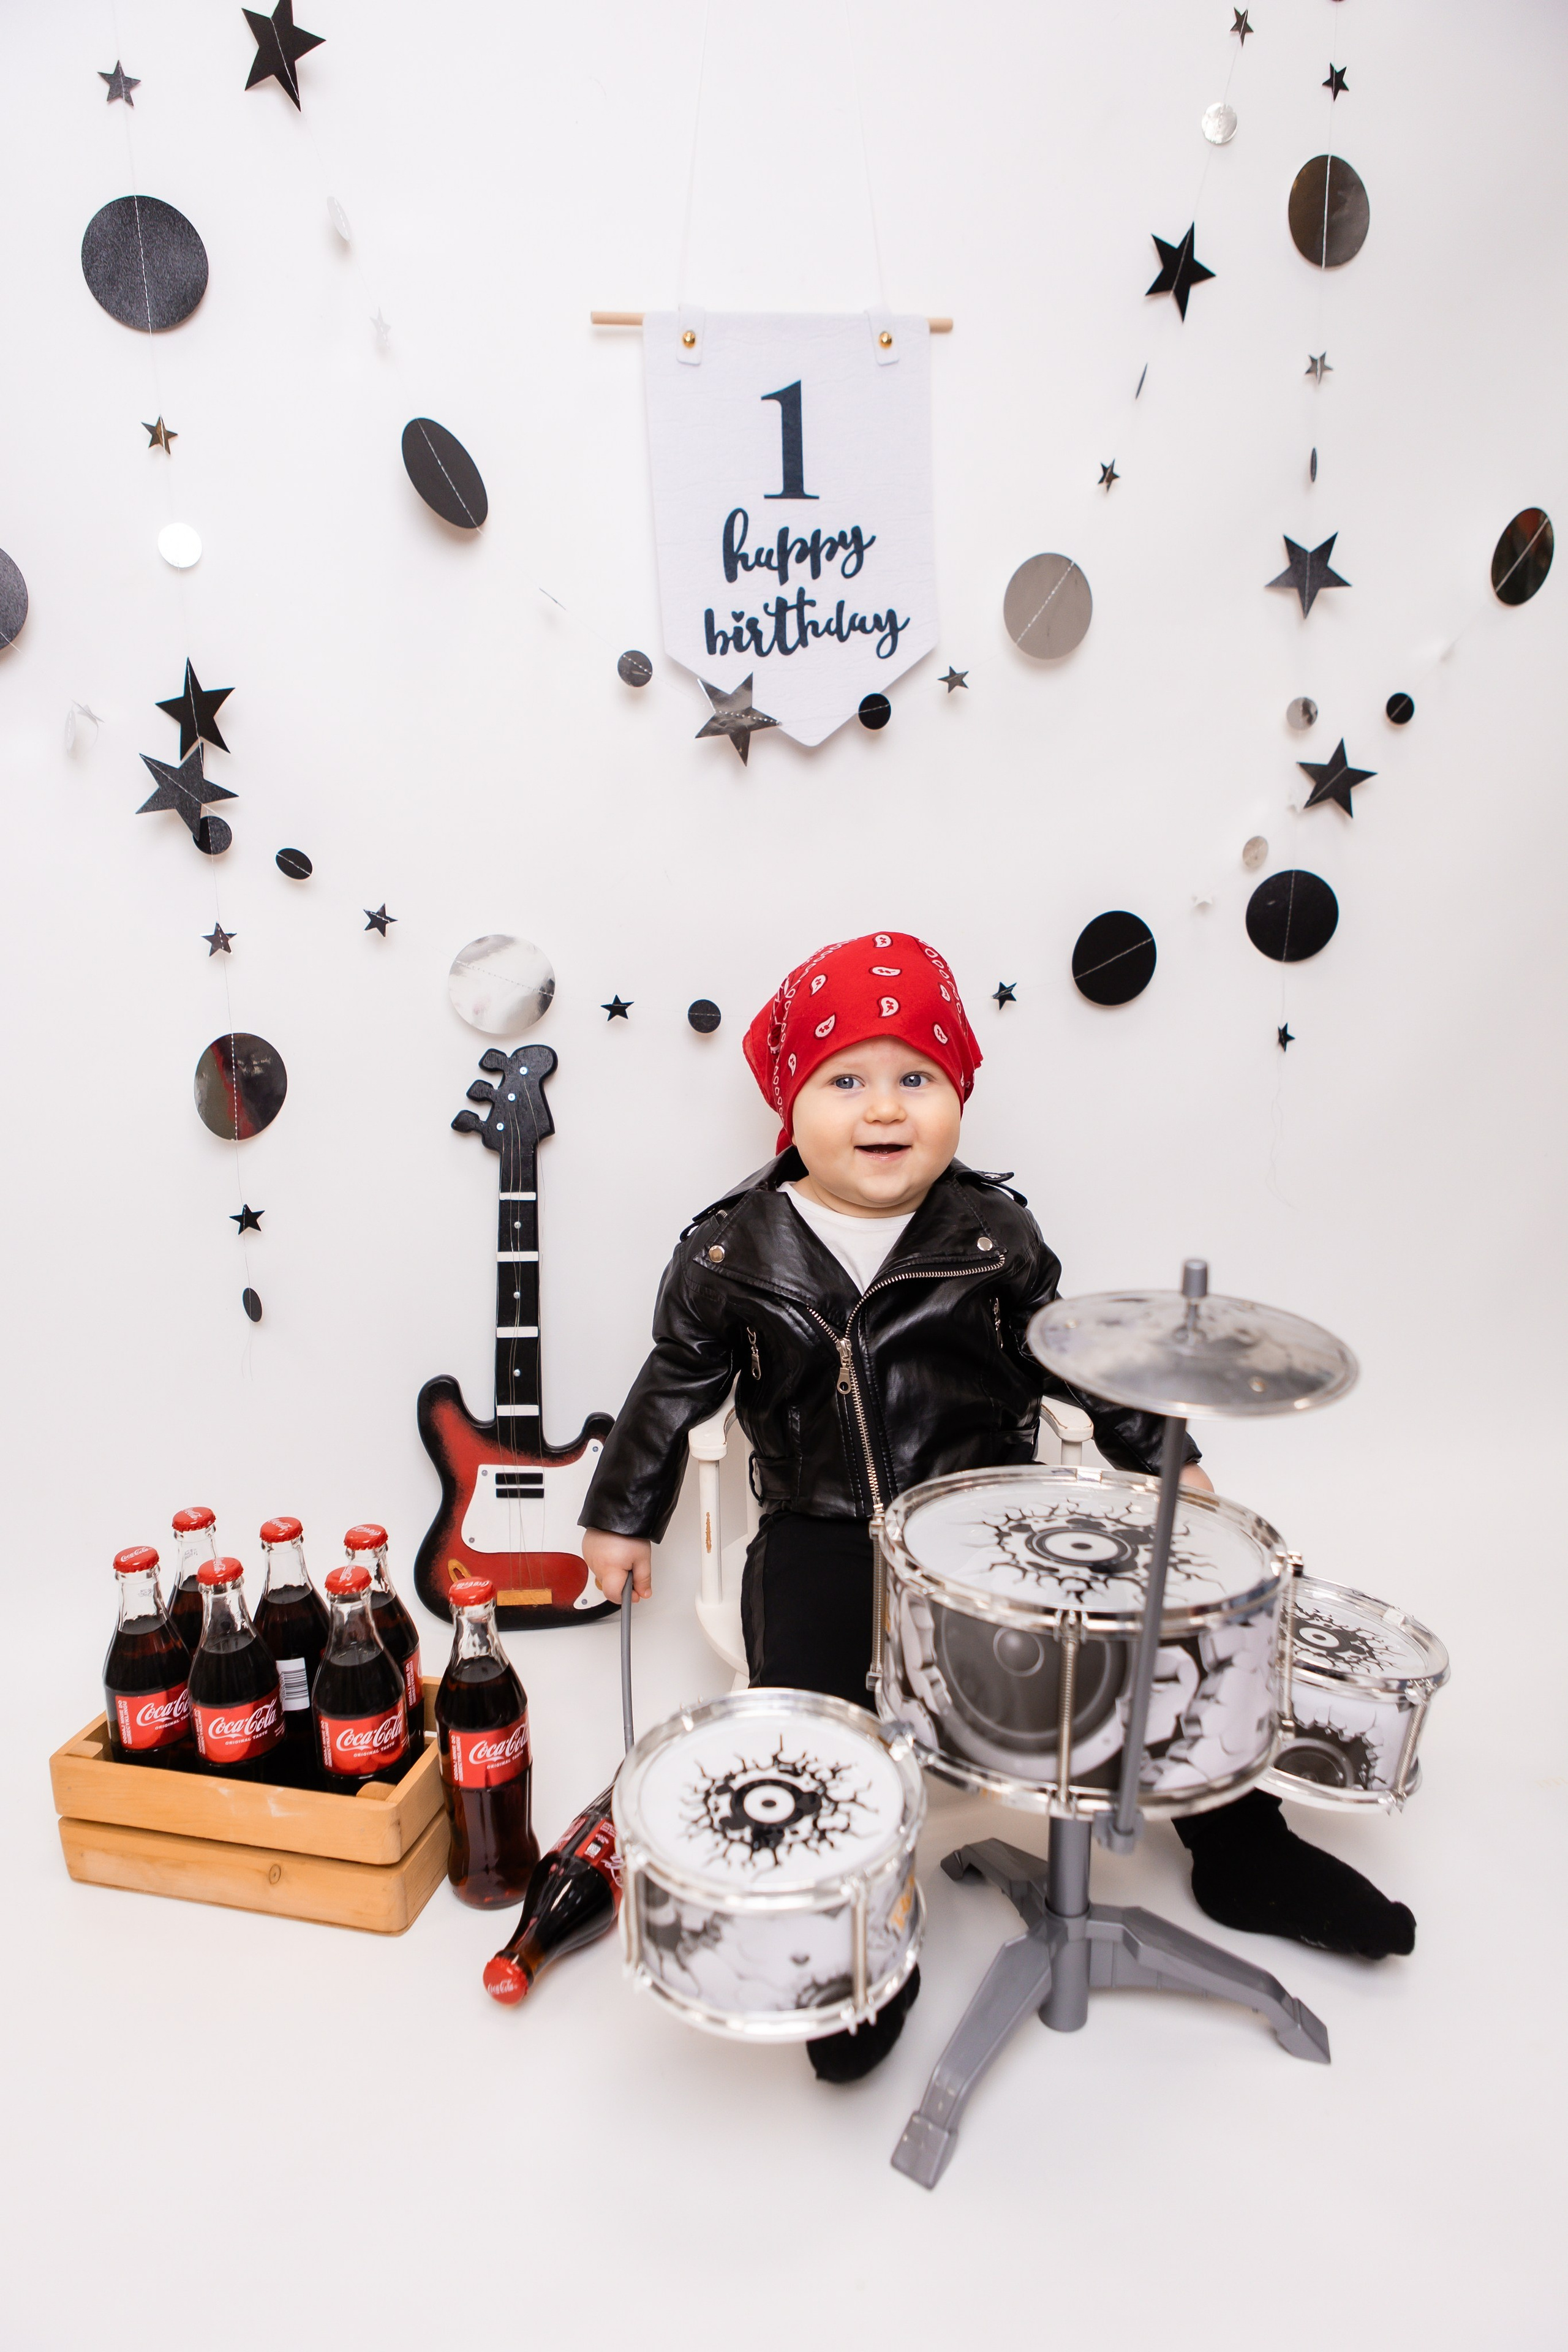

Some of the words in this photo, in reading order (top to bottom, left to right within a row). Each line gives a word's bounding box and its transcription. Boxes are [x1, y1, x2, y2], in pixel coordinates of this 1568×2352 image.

[761, 379, 820, 500] 1
[722, 507, 876, 586] happy
[704, 586, 910, 660] birthday
[120, 1546, 150, 1562] Coca-Cola
[136, 1688, 189, 1726] Coca-Co
[155, 1719, 180, 1730] ORIGINAL
[208, 1696, 277, 1740] Coca-Cola
[225, 1737, 251, 1746] ORIGINAL
[252, 1730, 268, 1740] TASTE
[336, 1709, 403, 1752] Coca-Cola
[353, 1749, 380, 1758] ORIGINAL
[381, 1741, 395, 1752] TASTE
[486, 1759, 511, 1770] ORIGINAL
